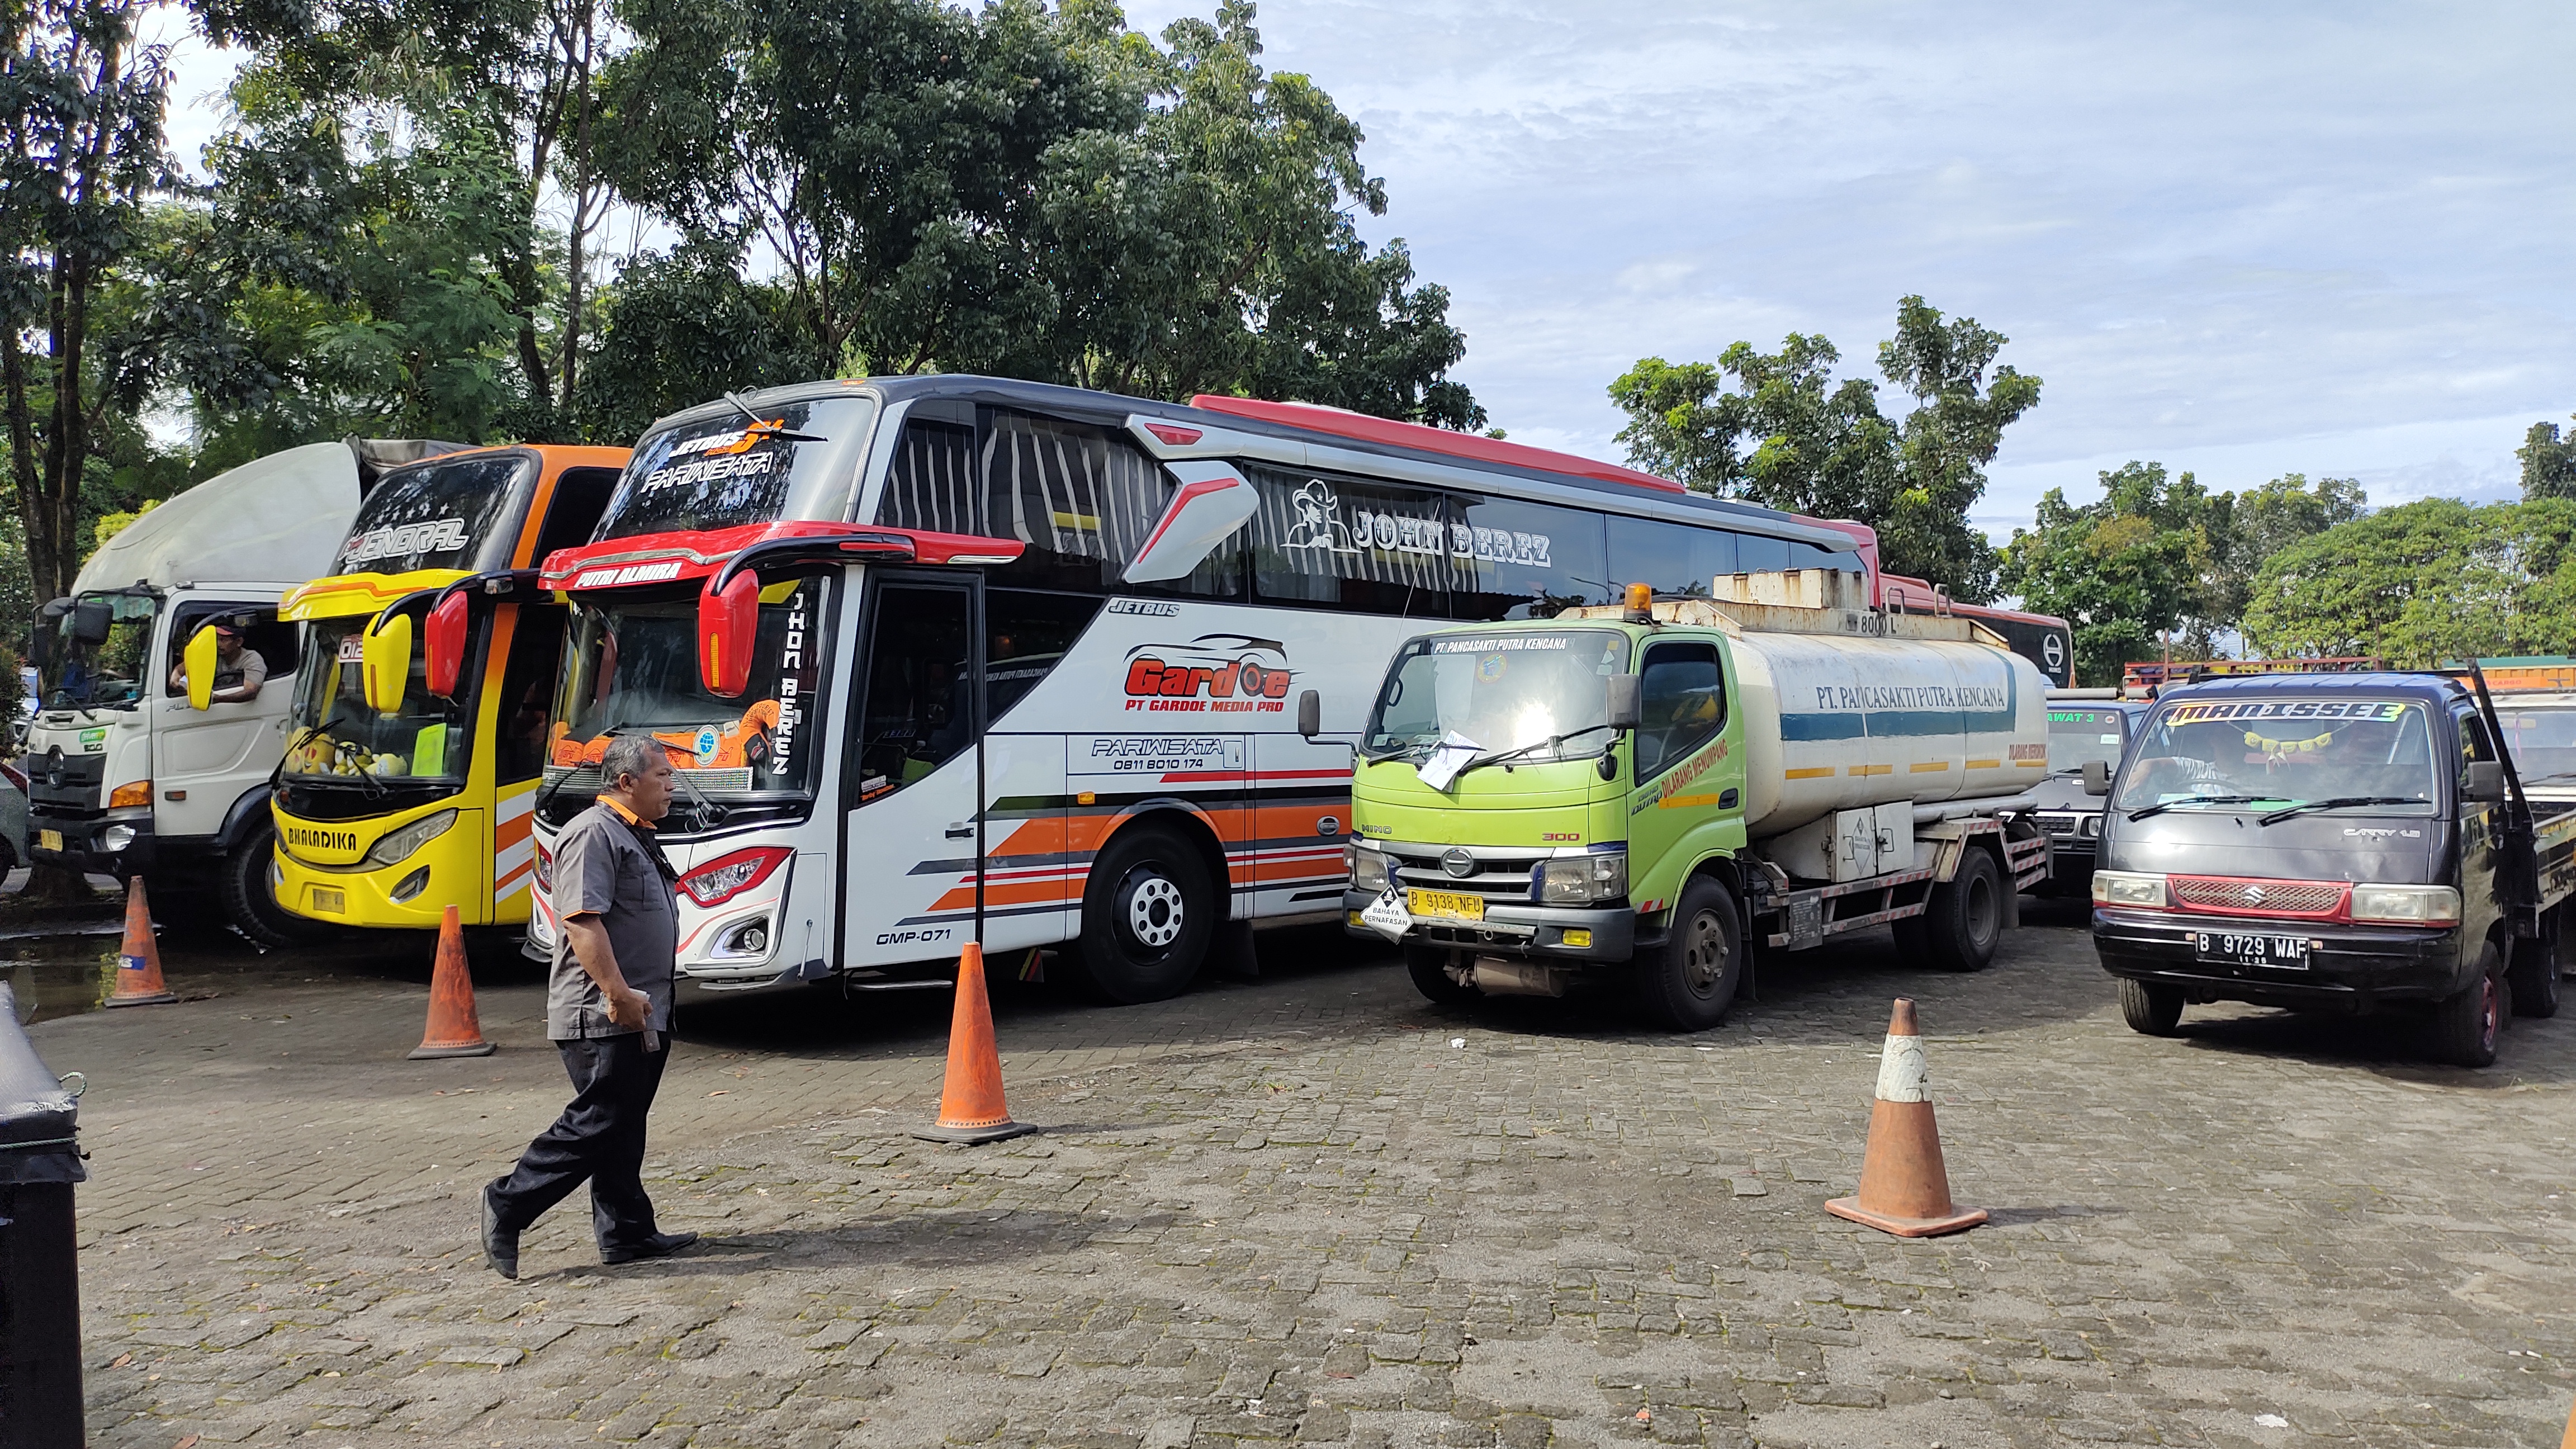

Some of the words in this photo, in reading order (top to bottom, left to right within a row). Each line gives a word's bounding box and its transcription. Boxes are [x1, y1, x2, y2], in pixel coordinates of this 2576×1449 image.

[669, 432, 746, 457] JETBUS
[339, 518, 469, 564] JENDRAL
[1352, 511, 1443, 556] JOHN
[1450, 523, 1551, 568] BEREZ
[574, 569, 620, 588] PUTRI
[614, 562, 683, 584] ALMIRA
[1110, 601, 1180, 616] JETBUS
[783, 593, 805, 669] JHON
[1862, 615, 1887, 634] 8000
[1891, 617, 1897, 634] L
[1447, 640, 1497, 653] PANCASAKTI
[1496, 638, 1523, 651] PUTRA
[1524, 638, 1566, 650] KENCANA
[1125, 700, 1145, 711] PT
[1149, 700, 1208, 712] GARDOE
[1210, 701, 1253, 712] MEDIA
[1257, 702, 1284, 712] PRO
[1816, 687, 1838, 709] PT.
[1839, 686, 1916, 708] PANCASAKTI
[1917, 686, 1956, 707] PUTRA
[1956, 687, 2005, 707] KENCANA
[2086, 713, 2095, 723] 3
[1092, 739, 1224, 756] PARIWISATA
[1114, 760, 1144, 770] 0811
[1147, 759, 1180, 769] 8010
[1183, 759, 1204, 768] 174
[1661, 763, 1693, 799] DILARANG
[1692, 738, 1728, 778] MENUMPANG
[1362, 825, 1392, 834] HINO
[1542, 832, 1580, 841] 300
[2343, 828, 2397, 836] CARRY
[288, 827, 357, 851] BHALADIKA
[1412, 891, 1418, 906] B
[1427, 894, 1454, 910] 9138
[1459, 897, 1481, 912] NFU
[1372, 907, 1399, 916] BAHAYA
[1365, 915, 1408, 926] PERNAFASAN
[876, 929, 951, 945] GMP-071
[2200, 934, 2209, 951] B
[2224, 935, 2265, 956] 9729
[2275, 937, 2307, 959] WAF
